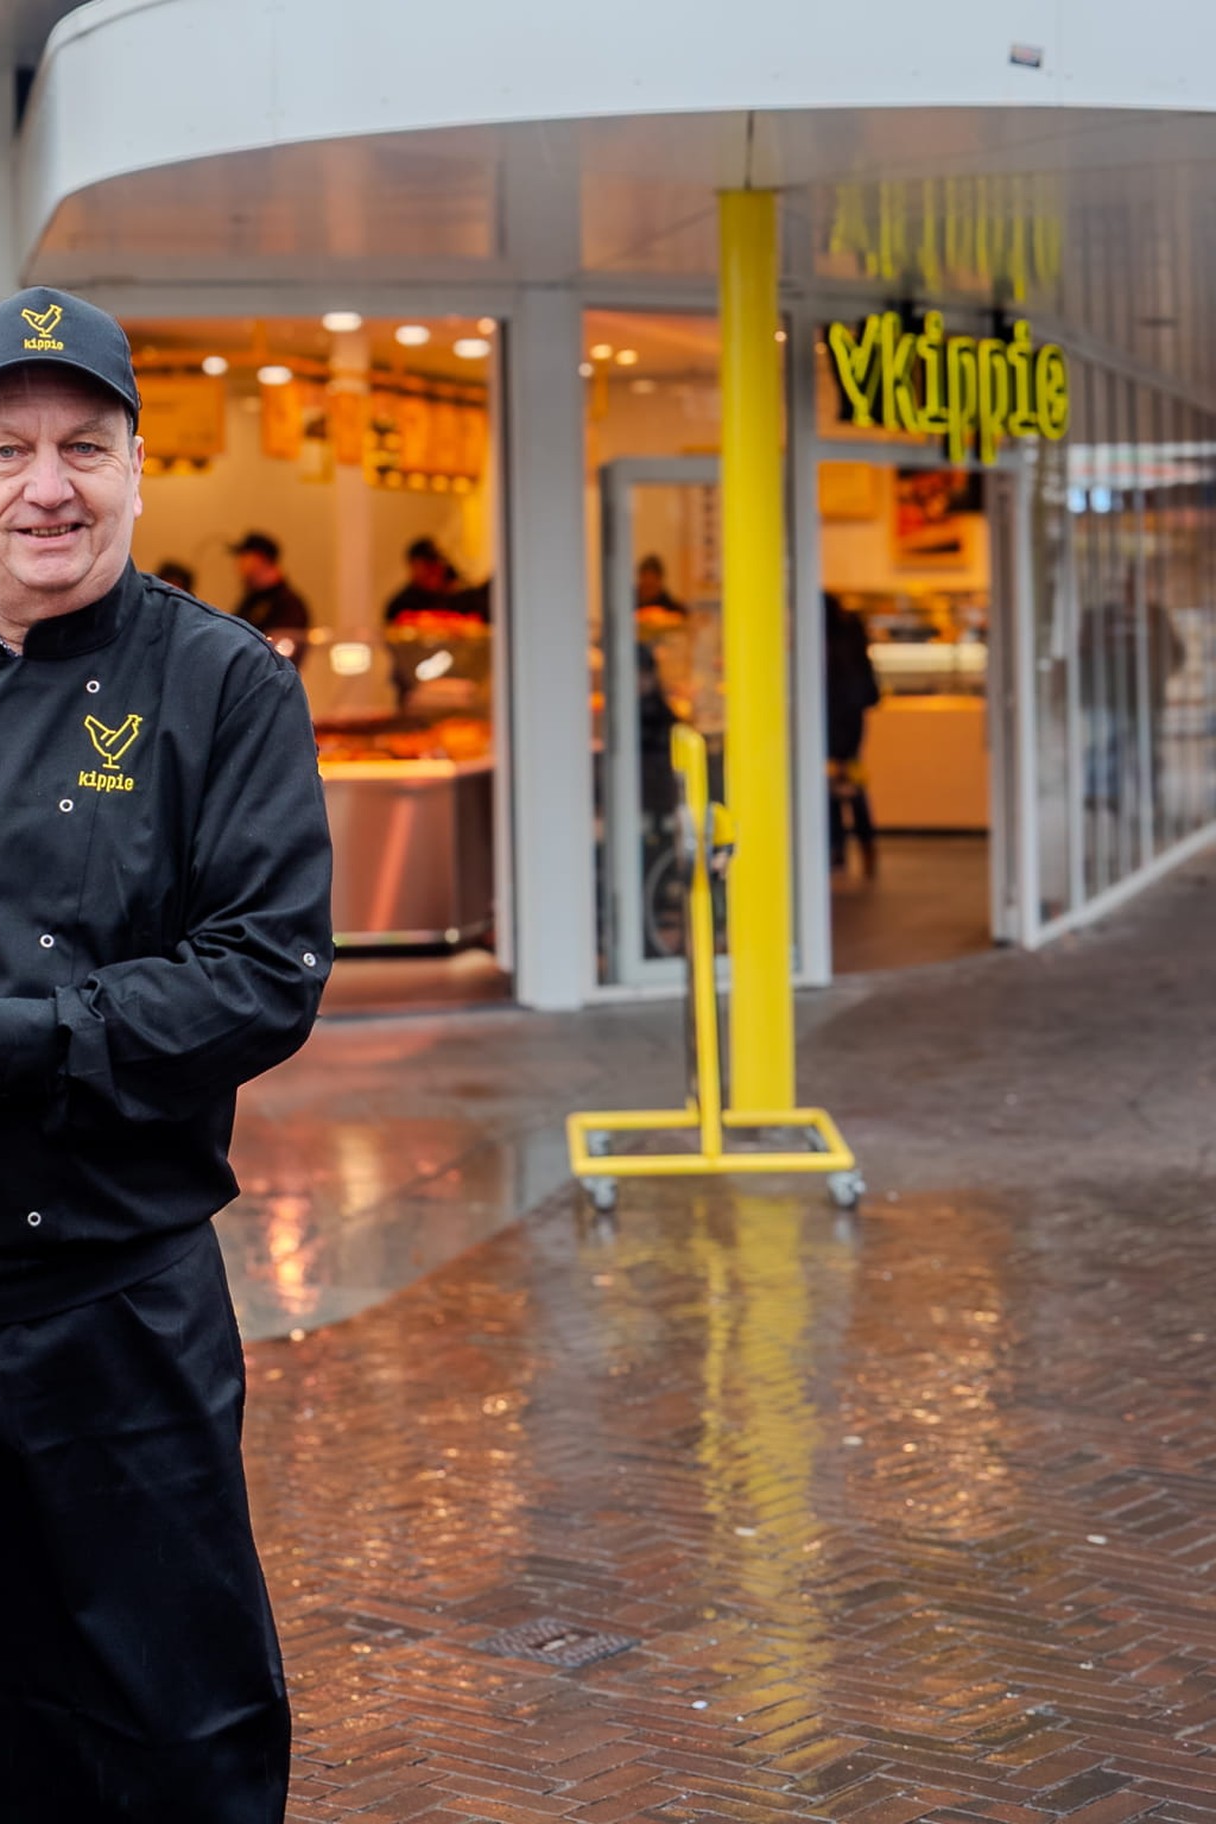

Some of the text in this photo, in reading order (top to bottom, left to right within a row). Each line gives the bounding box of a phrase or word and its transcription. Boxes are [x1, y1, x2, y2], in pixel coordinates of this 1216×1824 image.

[24, 338, 64, 351] kippie
[882, 310, 1070, 465] kippie
[78, 770, 134, 792] kippie
